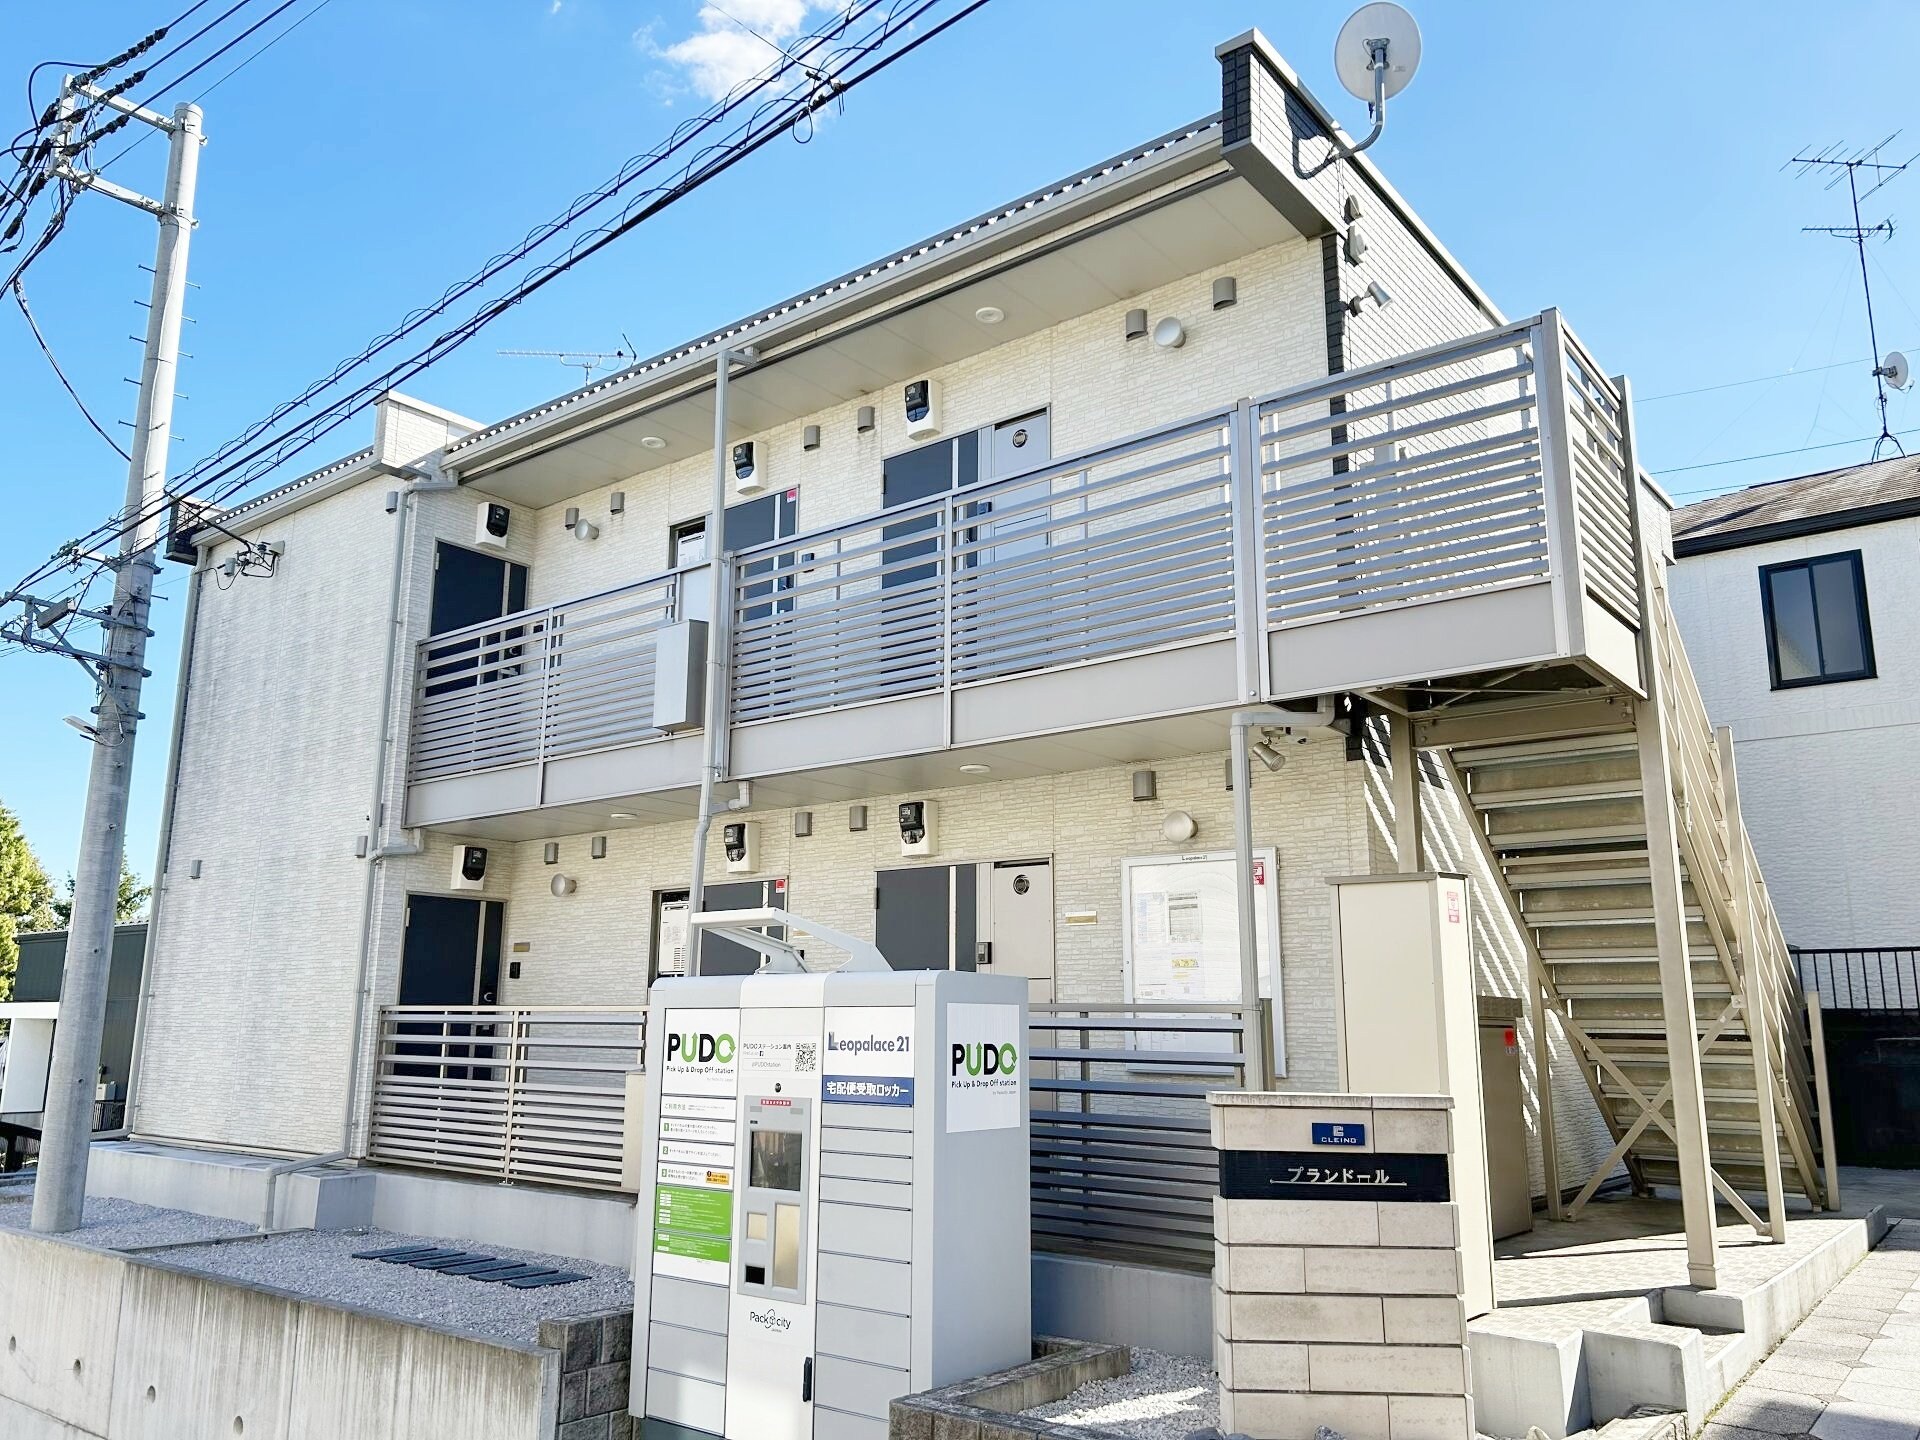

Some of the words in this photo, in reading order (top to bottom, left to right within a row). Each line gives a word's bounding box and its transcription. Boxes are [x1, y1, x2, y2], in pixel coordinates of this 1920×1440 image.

[667, 1032, 736, 1063] PUDO
[828, 1031, 895, 1056] Leopalace
[896, 1035, 909, 1052] 21
[952, 1042, 1017, 1076] PUDO
[677, 1066, 685, 1075] Up
[690, 1067, 704, 1075] Drop
[826, 1081, 909, 1097] 宅配便受取ロッカー
[963, 1081, 970, 1090] Up
[976, 1080, 989, 1088] Drop
[989, 1079, 999, 1087] Off
[1287, 1166, 1390, 1184] プランドール
